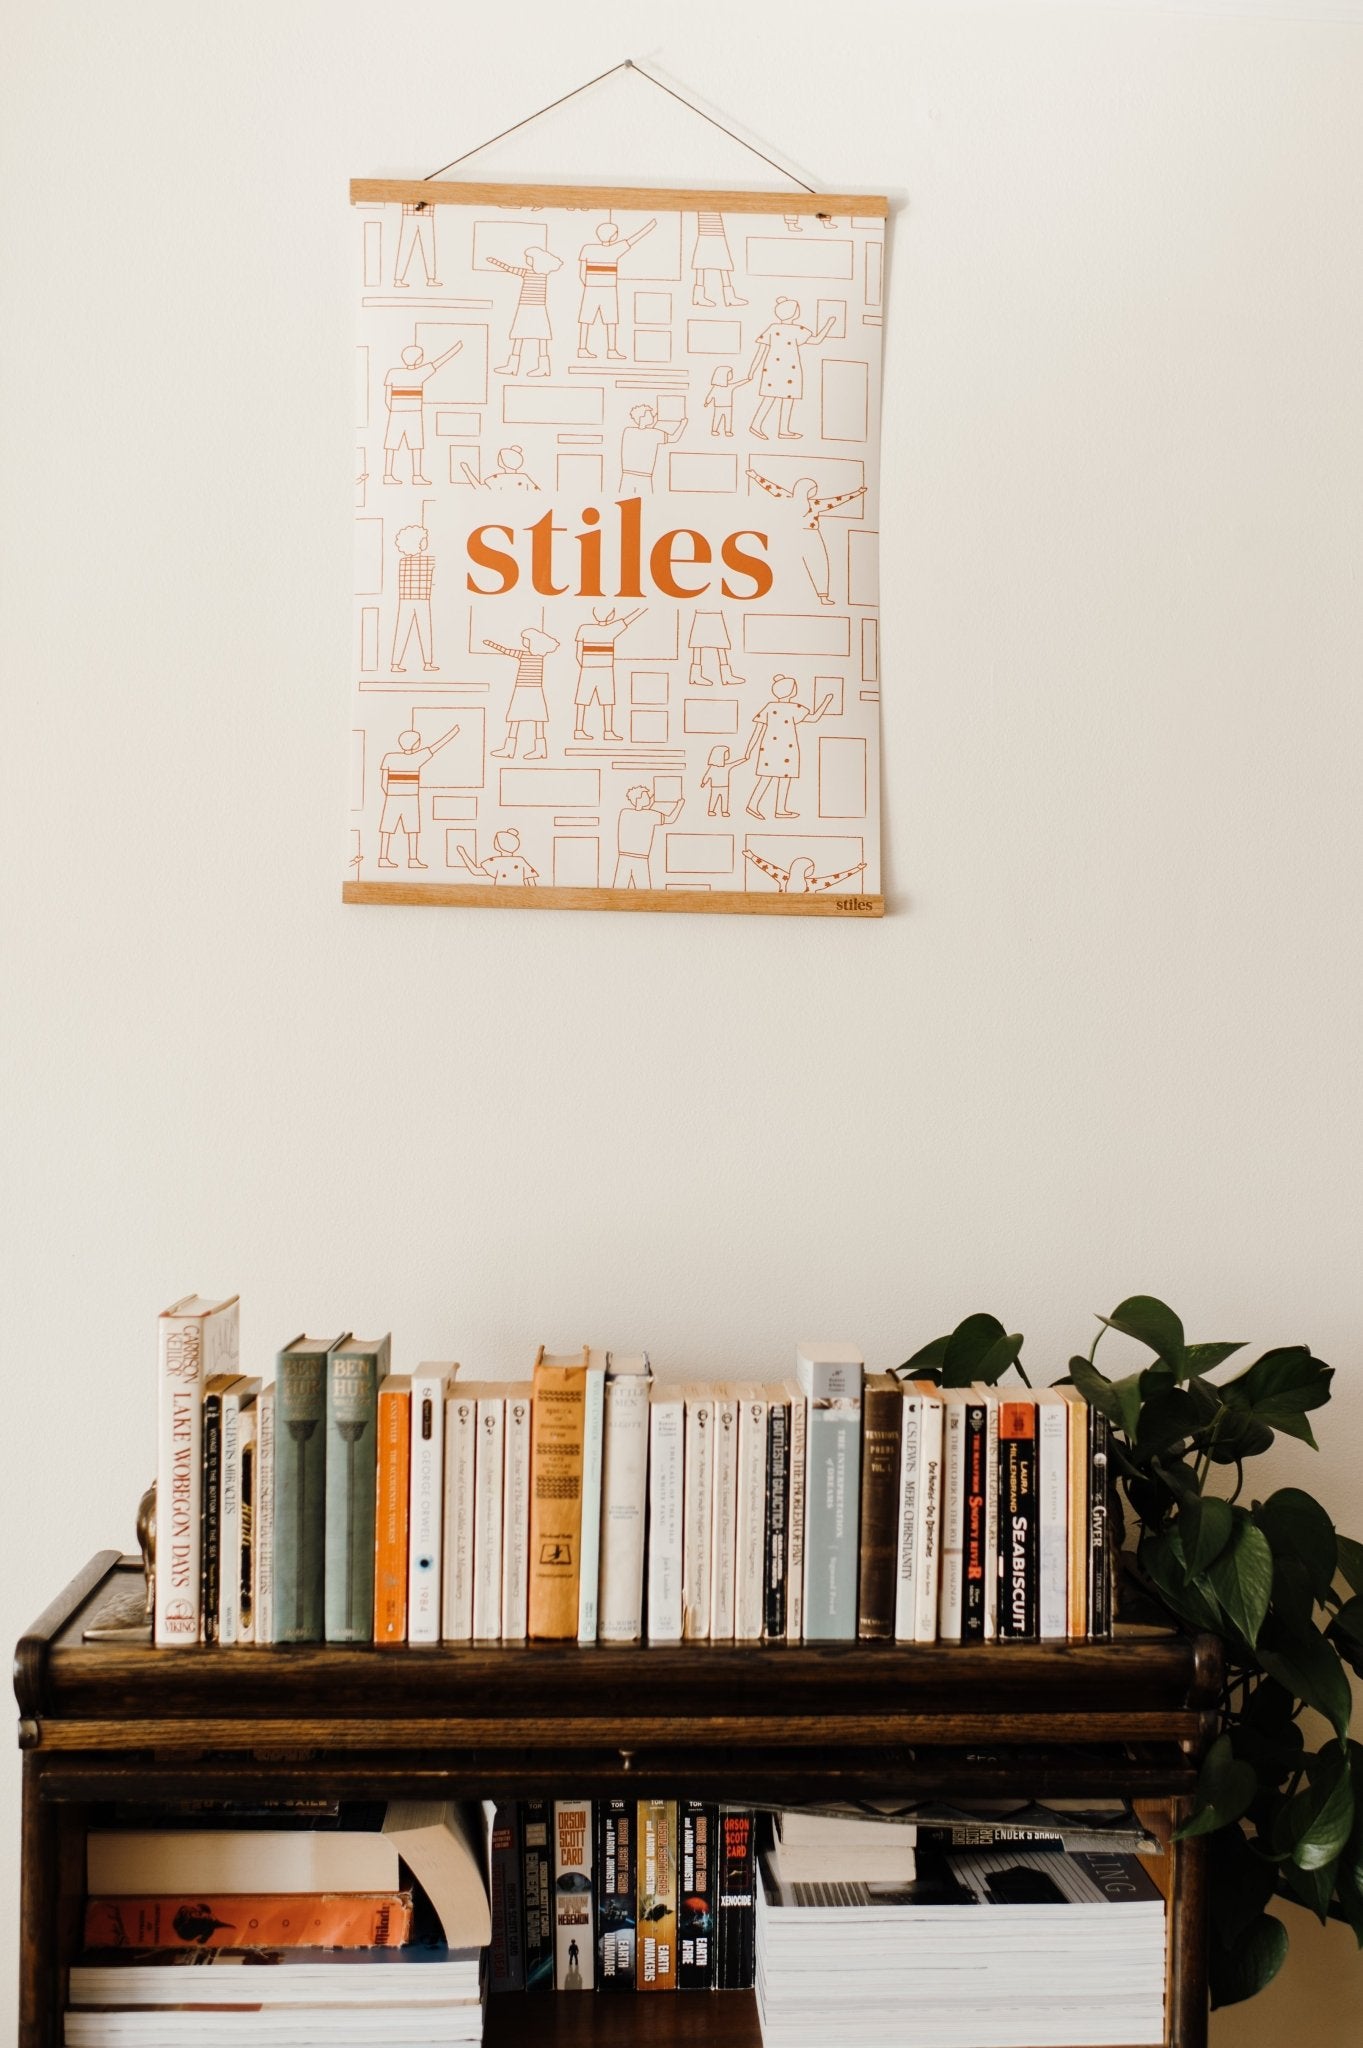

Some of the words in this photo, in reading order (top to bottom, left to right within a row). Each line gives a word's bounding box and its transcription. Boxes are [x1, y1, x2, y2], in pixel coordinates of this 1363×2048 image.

[466, 497, 773, 600] stiles
[836, 898, 873, 911] stiles
[166, 1332, 183, 1378] KEILLOR
[183, 1324, 201, 1385] GARRISON
[333, 1359, 369, 1377] BEN
[333, 1379, 369, 1396] HUR
[173, 1392, 192, 1442] LAKE
[209, 1427, 218, 1454] VOYAGE
[772, 1420, 784, 1477] BATTLESTAR
[838, 1430, 846, 1450] THE
[951, 1436, 959, 1451] THE
[209, 1457, 218, 1466] TO
[421, 1449, 432, 1496] GEORGE
[793, 1459, 803, 1479] THE
[951, 1453, 959, 1494] CATCHER
[989, 1460, 997, 1478] THE
[209, 1470, 218, 1482] THE
[225, 1463, 237, 1515] MIRACLES
[826, 1467, 834, 1509] DREAMS
[1010, 1443, 1018, 1513] HILLENBRAND
[1020, 1461, 1028, 1494] LAURA
[172, 1449, 192, 1538] WOBEGON
[209, 1486, 218, 1513] BOTTOM
[772, 1479, 784, 1529] GALACTICA
[792, 1481, 803, 1527] PROBLEM
[836, 1452, 845, 1539] INTERPRETATION
[904, 1480, 916, 1508] MERE
[209, 1516, 217, 1525] OF
[420, 1501, 431, 1543] ORWELL
[950, 1509, 958, 1528] THE
[968, 1496, 982, 1539] SNOWY
[1092, 1506, 1106, 1547] GIVER
[209, 1530, 217, 1542] THE
[792, 1529, 802, 1541] OF
[902, 1510, 914, 1581] CHRISTIANITY
[209, 1545, 217, 1558] SEA
[792, 1543, 802, 1567] PAIN
[968, 1541, 982, 1579] RIVER
[171, 1544, 191, 1588] DAYS
[1012, 1516, 1027, 1631] SEABISCUIT
[420, 1586, 429, 1613] 1984
[165, 1620, 195, 1633] VIKING
[558, 1811, 586, 1830] ORSON
[618, 1818, 628, 1844] ORSON
[658, 1820, 668, 1846] ORSON
[696, 1816, 706, 1844] ORSON
[724, 1818, 750, 1830] ORSON
[560, 1830, 586, 1847] SCOTT
[606, 1831, 615, 1855] AARON
[646, 1832, 655, 1856] AARON
[684, 1830, 694, 1854] AARON
[726, 1832, 748, 1844] SCOTT
[994, 1829, 1032, 1840] ENDERS
[561, 1848, 583, 1866] CARD
[618, 1846, 628, 1870] SCOTT
[658, 1848, 668, 1872] SCOTT
[696, 1845, 706, 1869] SCOTT
[727, 1846, 746, 1857] CARD
[526, 1852, 539, 1906] ENDER'S
[540, 1861, 548, 1888] ORSON
[606, 1857, 615, 1893] JOHNSTON
[618, 1872, 628, 1894] CARD
[646, 1858, 655, 1895] JOHNSTON
[658, 1874, 668, 1896] CARD
[684, 1855, 694, 1892] JOHNSTON
[696, 1871, 706, 1892] CARD
[540, 1888, 548, 1914] SCOTT
[721, 1895, 752, 1906] XENOCIDE
[528, 1909, 540, 1948] GAME
[541, 1915, 550, 1937] CARD
[558, 1914, 589, 1926] HEGEMON
[604, 1933, 616, 1976] UNAWARE
[618, 1940, 629, 1968] EARTH
[644, 1938, 656, 1982] AWAKENS
[658, 1944, 669, 1973] EARTH
[682, 1940, 694, 1964] AFIRE
[696, 1938, 708, 1966] EARTH
